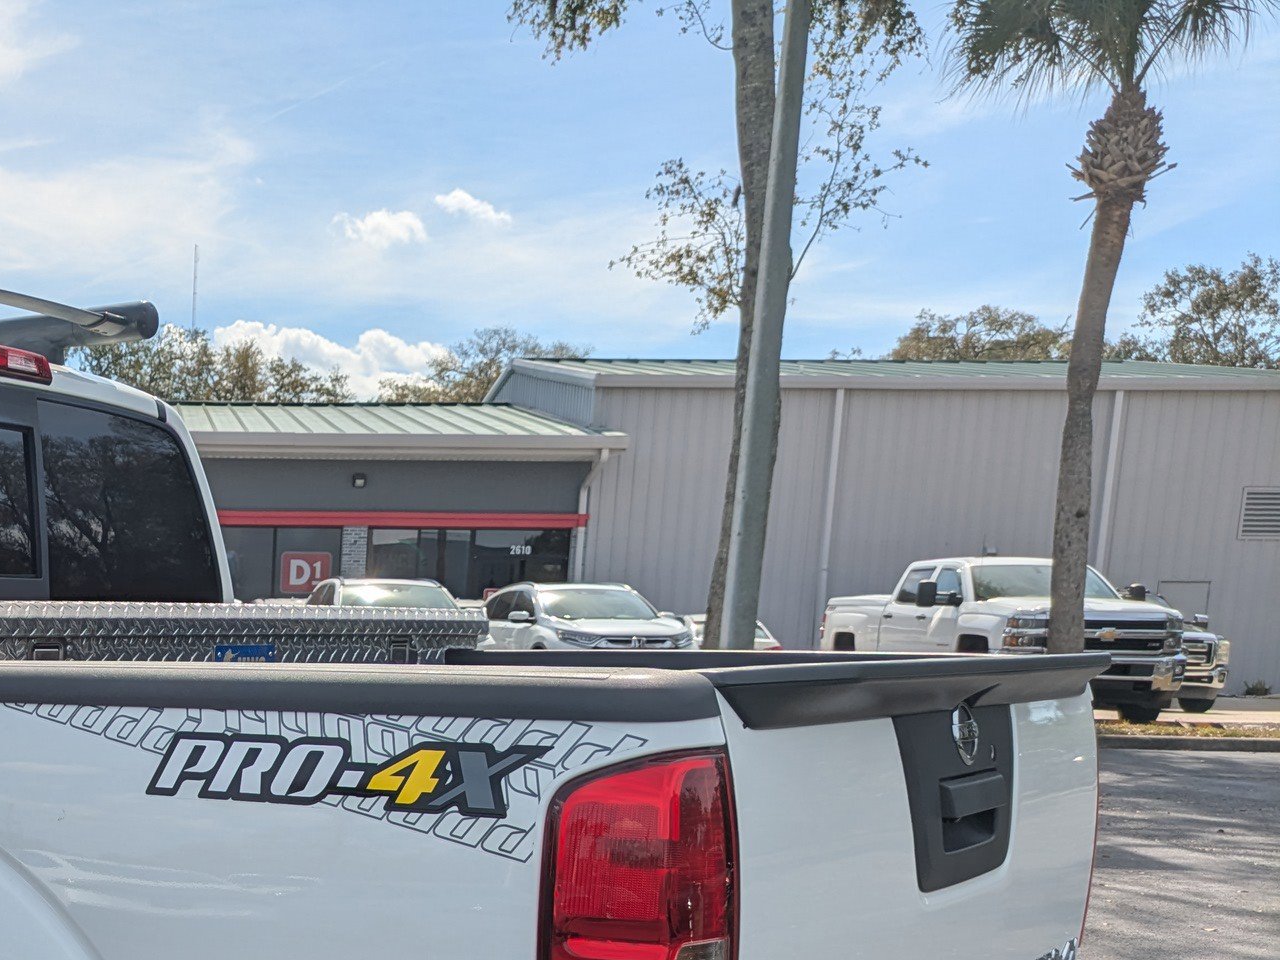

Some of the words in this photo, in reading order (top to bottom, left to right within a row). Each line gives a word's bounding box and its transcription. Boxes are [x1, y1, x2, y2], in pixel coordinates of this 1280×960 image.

[510, 545, 532, 555] 2610
[289, 559, 322, 586] D1
[149, 733, 544, 815] PRO-4X
